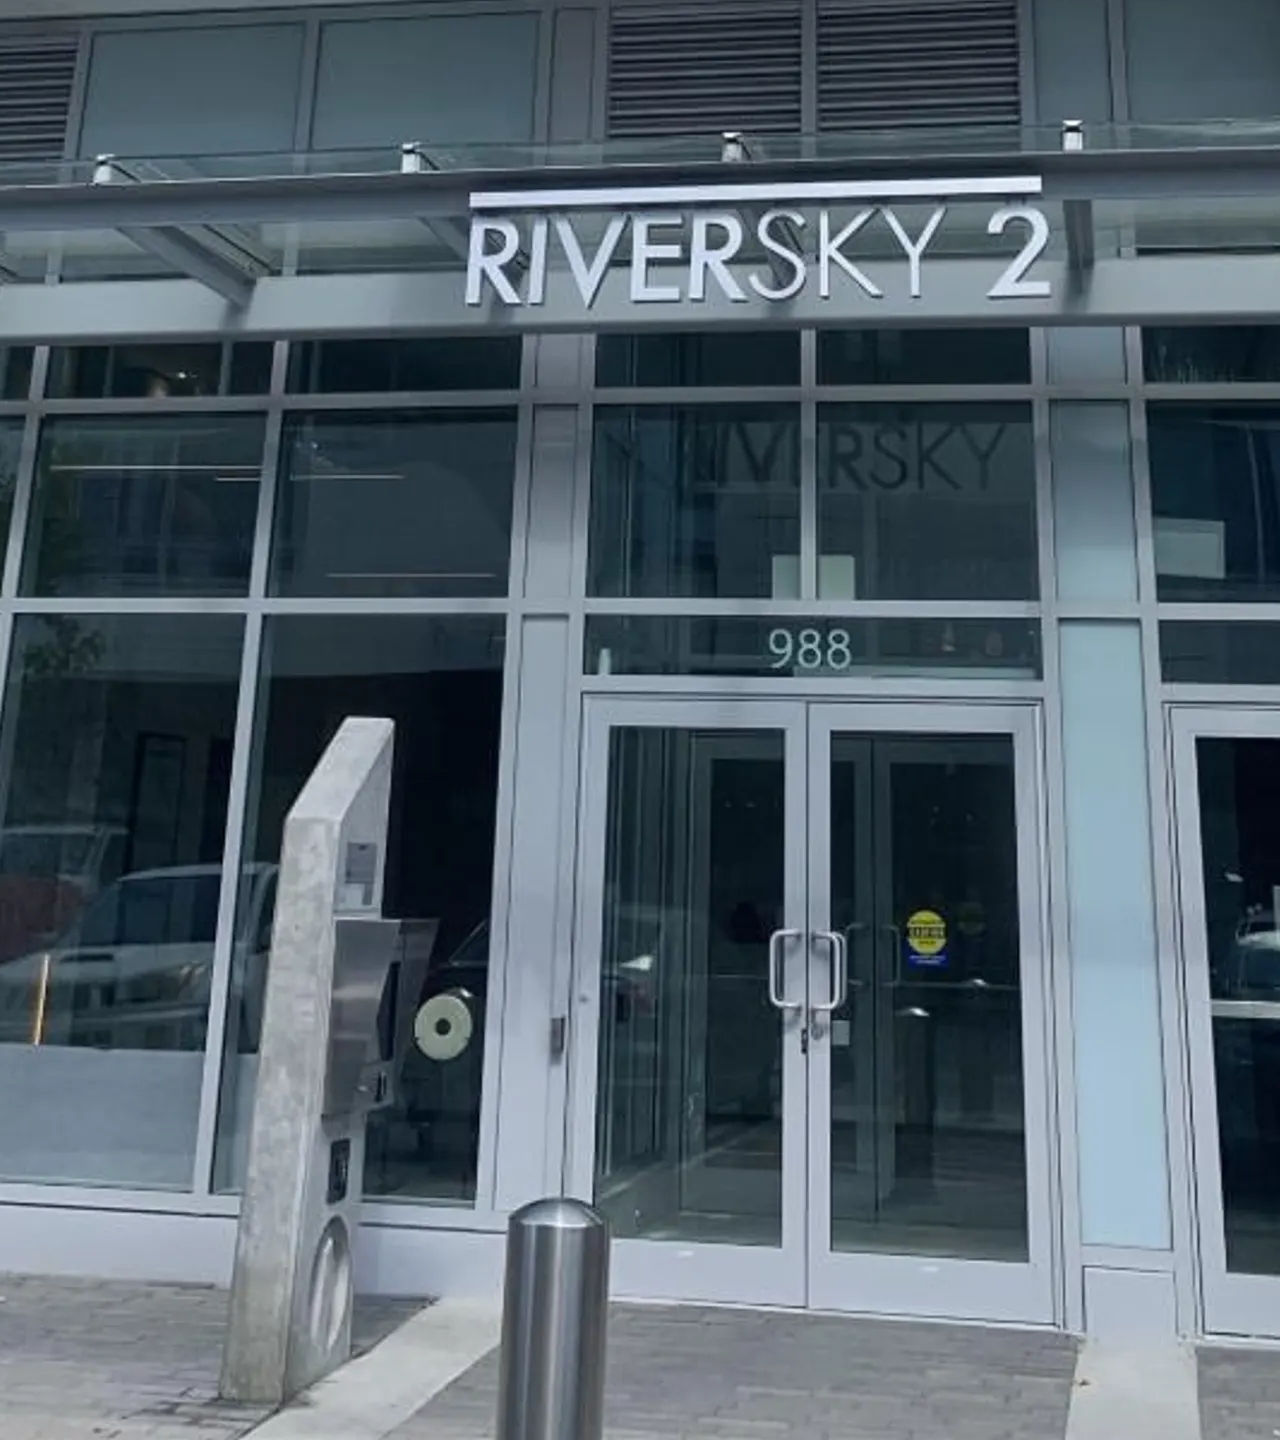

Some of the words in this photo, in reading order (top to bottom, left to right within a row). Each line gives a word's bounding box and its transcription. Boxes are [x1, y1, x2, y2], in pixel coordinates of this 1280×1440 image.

[465, 206, 947, 308] RIVERSKY
[987, 206, 1052, 298] 2
[769, 628, 851, 669] 988
